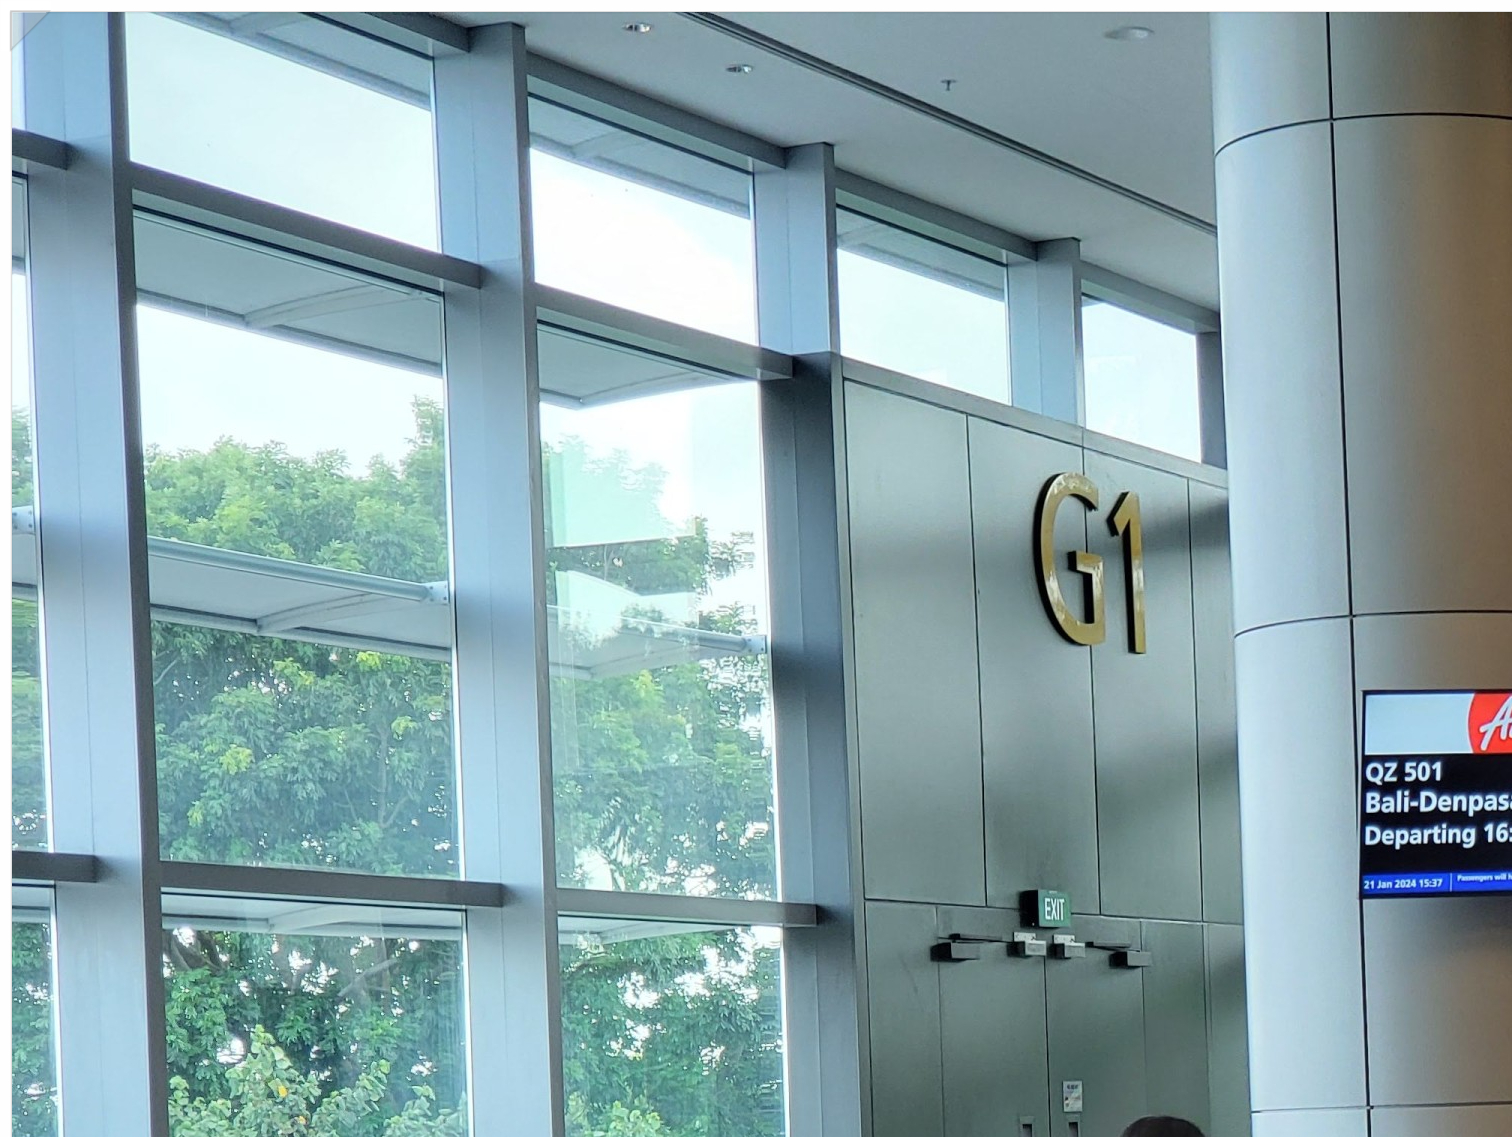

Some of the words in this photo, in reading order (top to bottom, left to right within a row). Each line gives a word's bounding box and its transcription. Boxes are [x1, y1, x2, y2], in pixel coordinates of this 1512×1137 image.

[1033, 471, 1147, 654] G1
[1366, 762, 1398, 784] QZ
[1404, 761, 1442, 782] 501
[1365, 824, 1476, 849] Departing
[1364, 880, 1374, 890] 21
[1377, 880, 1392, 889] Jan
[1394, 879, 1416, 888] 2024
[1419, 878, 1443, 888] 15:37
[1457, 874, 1493, 882] Passengers
[1044, 897, 1065, 921] EXIT
